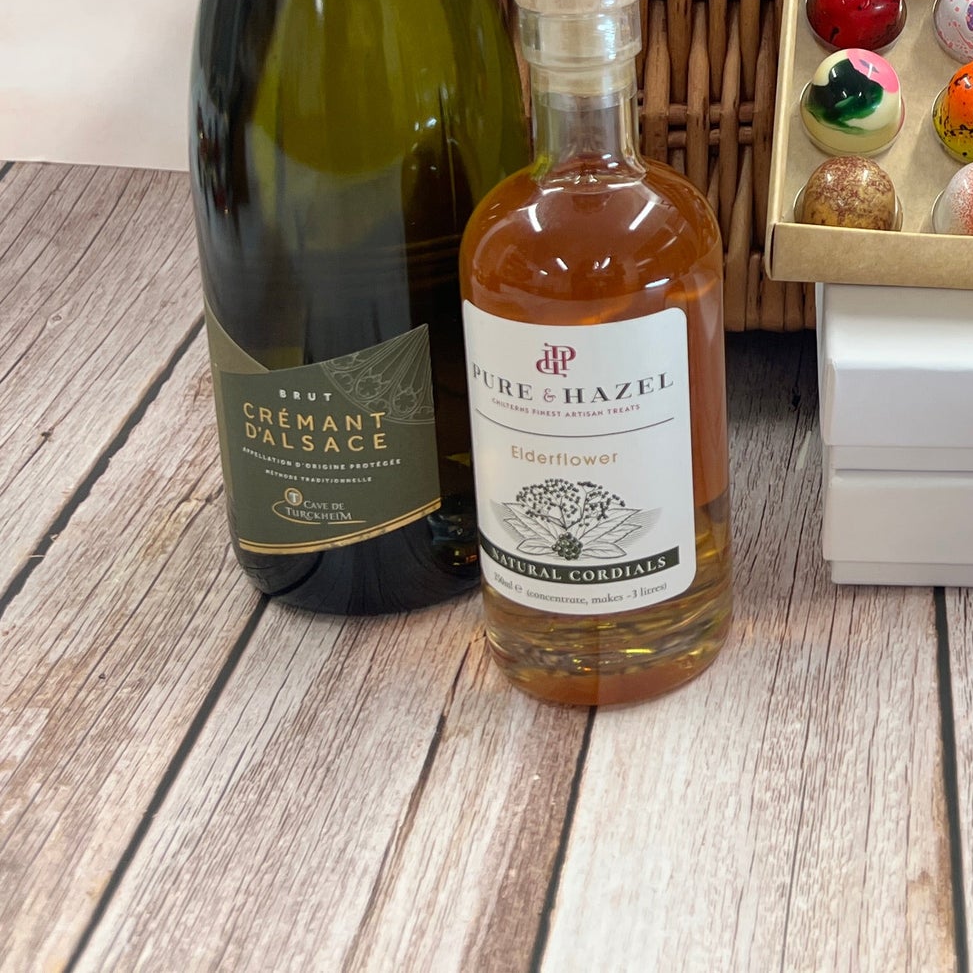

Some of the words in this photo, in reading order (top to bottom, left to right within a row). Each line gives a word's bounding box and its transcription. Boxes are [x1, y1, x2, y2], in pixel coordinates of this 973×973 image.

[472, 362, 533, 401] PURE
[543, 387, 556, 403] &
[562, 371, 674, 404] HAZEL
[279, 389, 332, 402] BRUT
[243, 402, 386, 432] CRÉMANT
[491, 397, 530, 414] CHILTERNS
[532, 408, 561, 417] FINEST
[565, 408, 604, 418] ARTISAN
[607, 404, 640, 415] TREATS
[245, 422, 387, 453] D'ALSACE
[242, 446, 292, 467] APPELLATION
[295, 461, 346, 470] D'ORIGINE
[511, 445, 618, 467] Elderflower
[300, 476, 372, 484] TRADITIONNELLE
[285, 506, 352, 520] TURCKHEIM
[303, 500, 329, 510] CAVE
[331, 502, 345, 510] DE
[492, 547, 562, 580] NATURAL
[569, 555, 667, 582] CORDIALS
[526, 589, 589, 606] (concentrate,
[591, 592, 624, 604] makes
[640, 582, 667, 597] litres)
